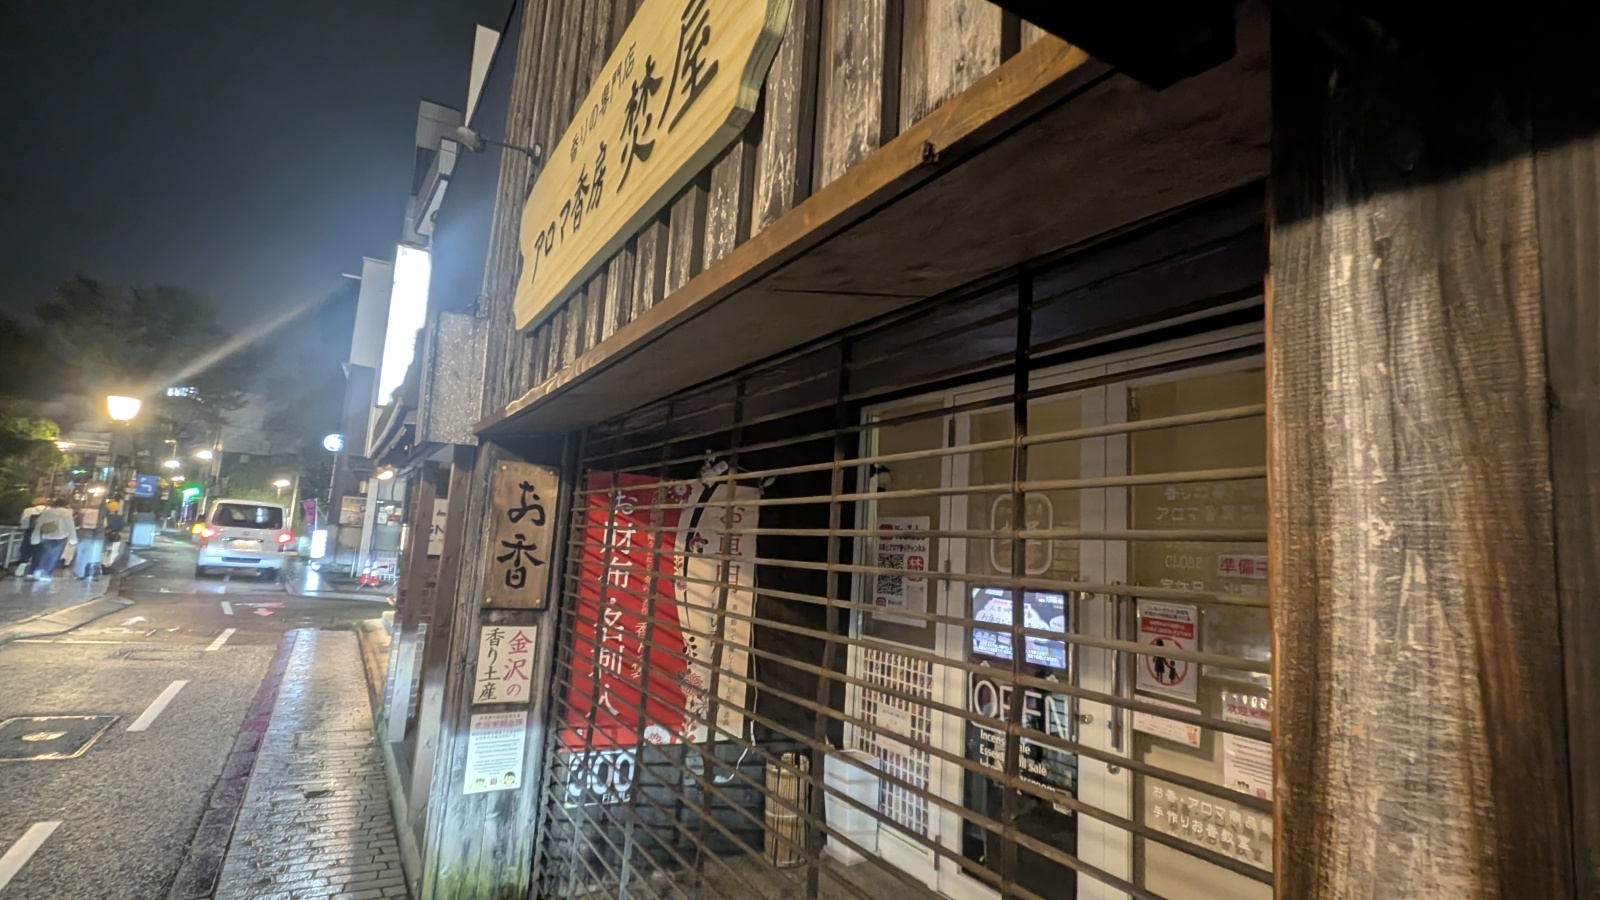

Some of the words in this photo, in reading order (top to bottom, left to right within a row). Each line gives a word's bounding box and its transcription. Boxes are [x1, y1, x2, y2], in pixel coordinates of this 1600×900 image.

[569, 40, 637, 163] 香りの専門店
[531, 140, 608, 285] アロマ香房
[497, 480, 546, 589] お香
[479, 627, 506, 701] 香り土産
[502, 630, 533, 696] 金沢の
[974, 680, 1070, 741] OPEN
[1029, 763, 1048, 777] sale
